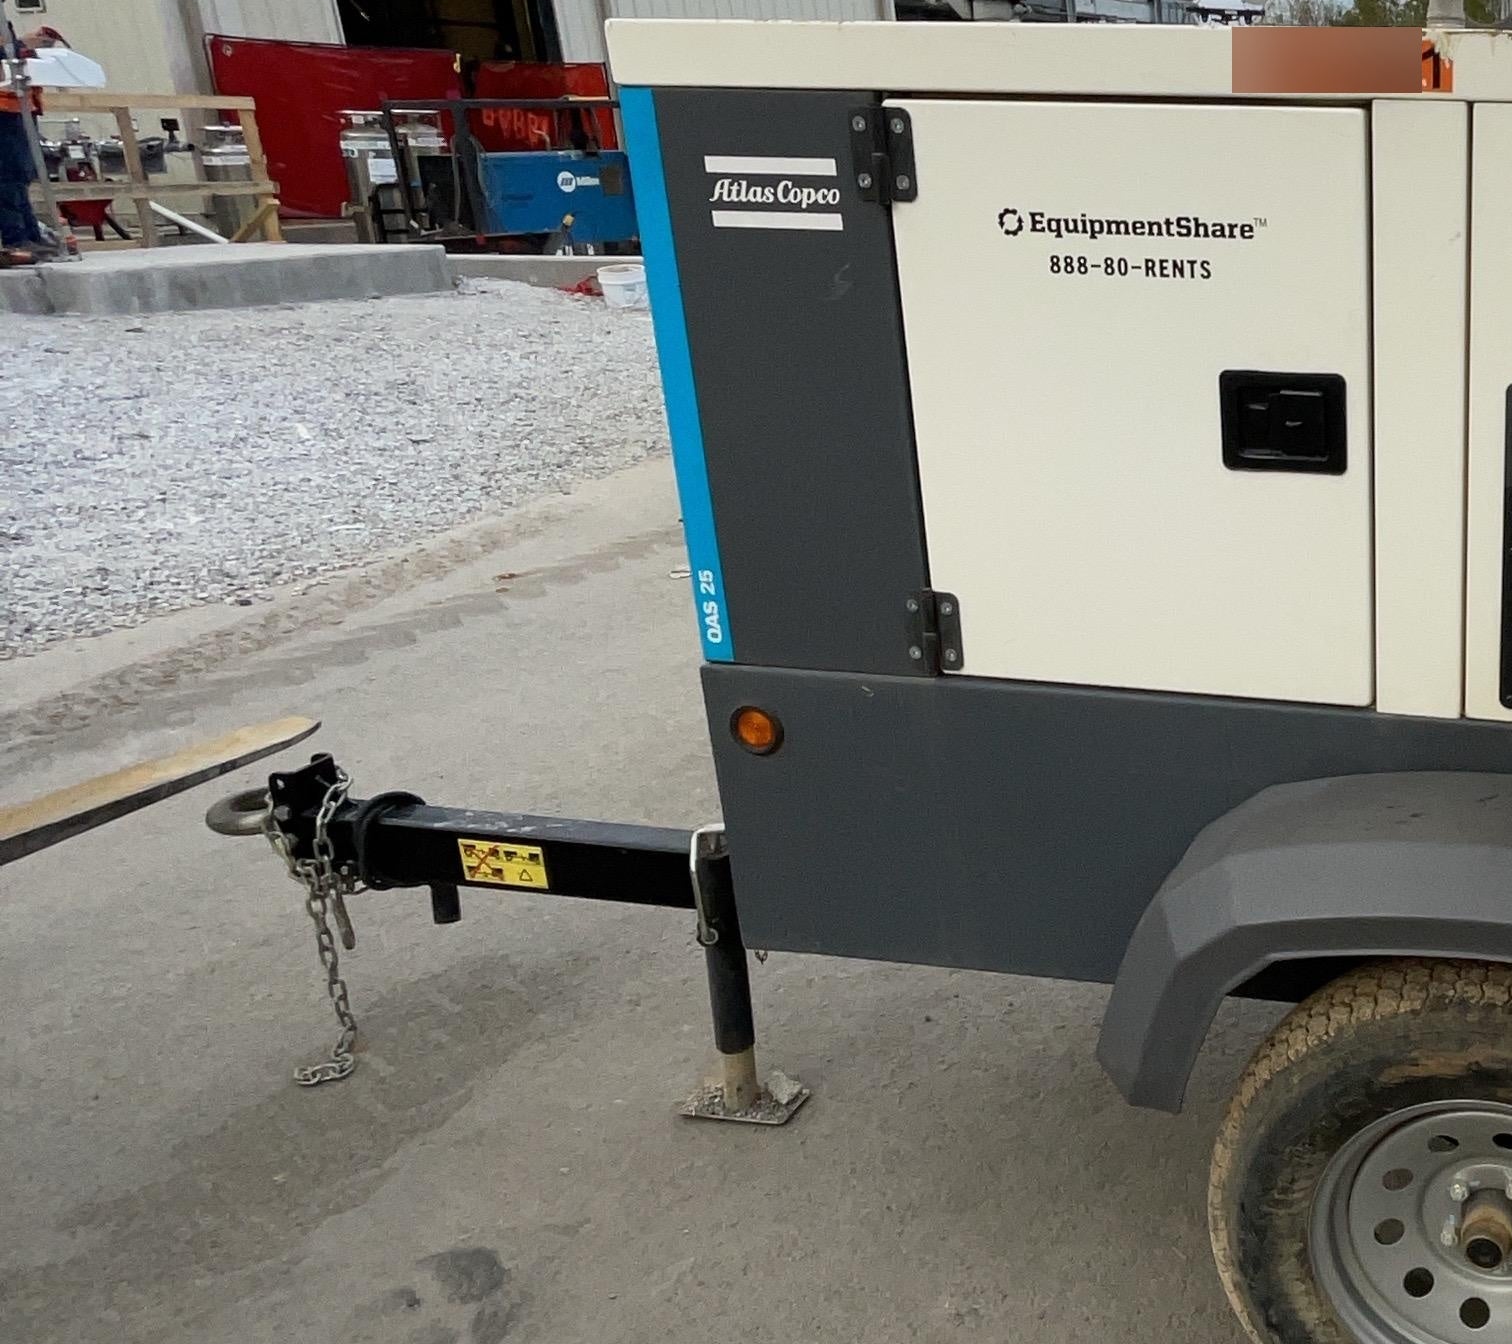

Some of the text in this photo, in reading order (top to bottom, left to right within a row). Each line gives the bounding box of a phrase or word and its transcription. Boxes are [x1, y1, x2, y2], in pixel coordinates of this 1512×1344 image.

[709, 178, 841, 209] Atlas Copco
[1028, 211, 1255, 240] EquipmentShare
[1049, 254, 1212, 280] 888-80-RENTS
[698, 569, 716, 596] 25
